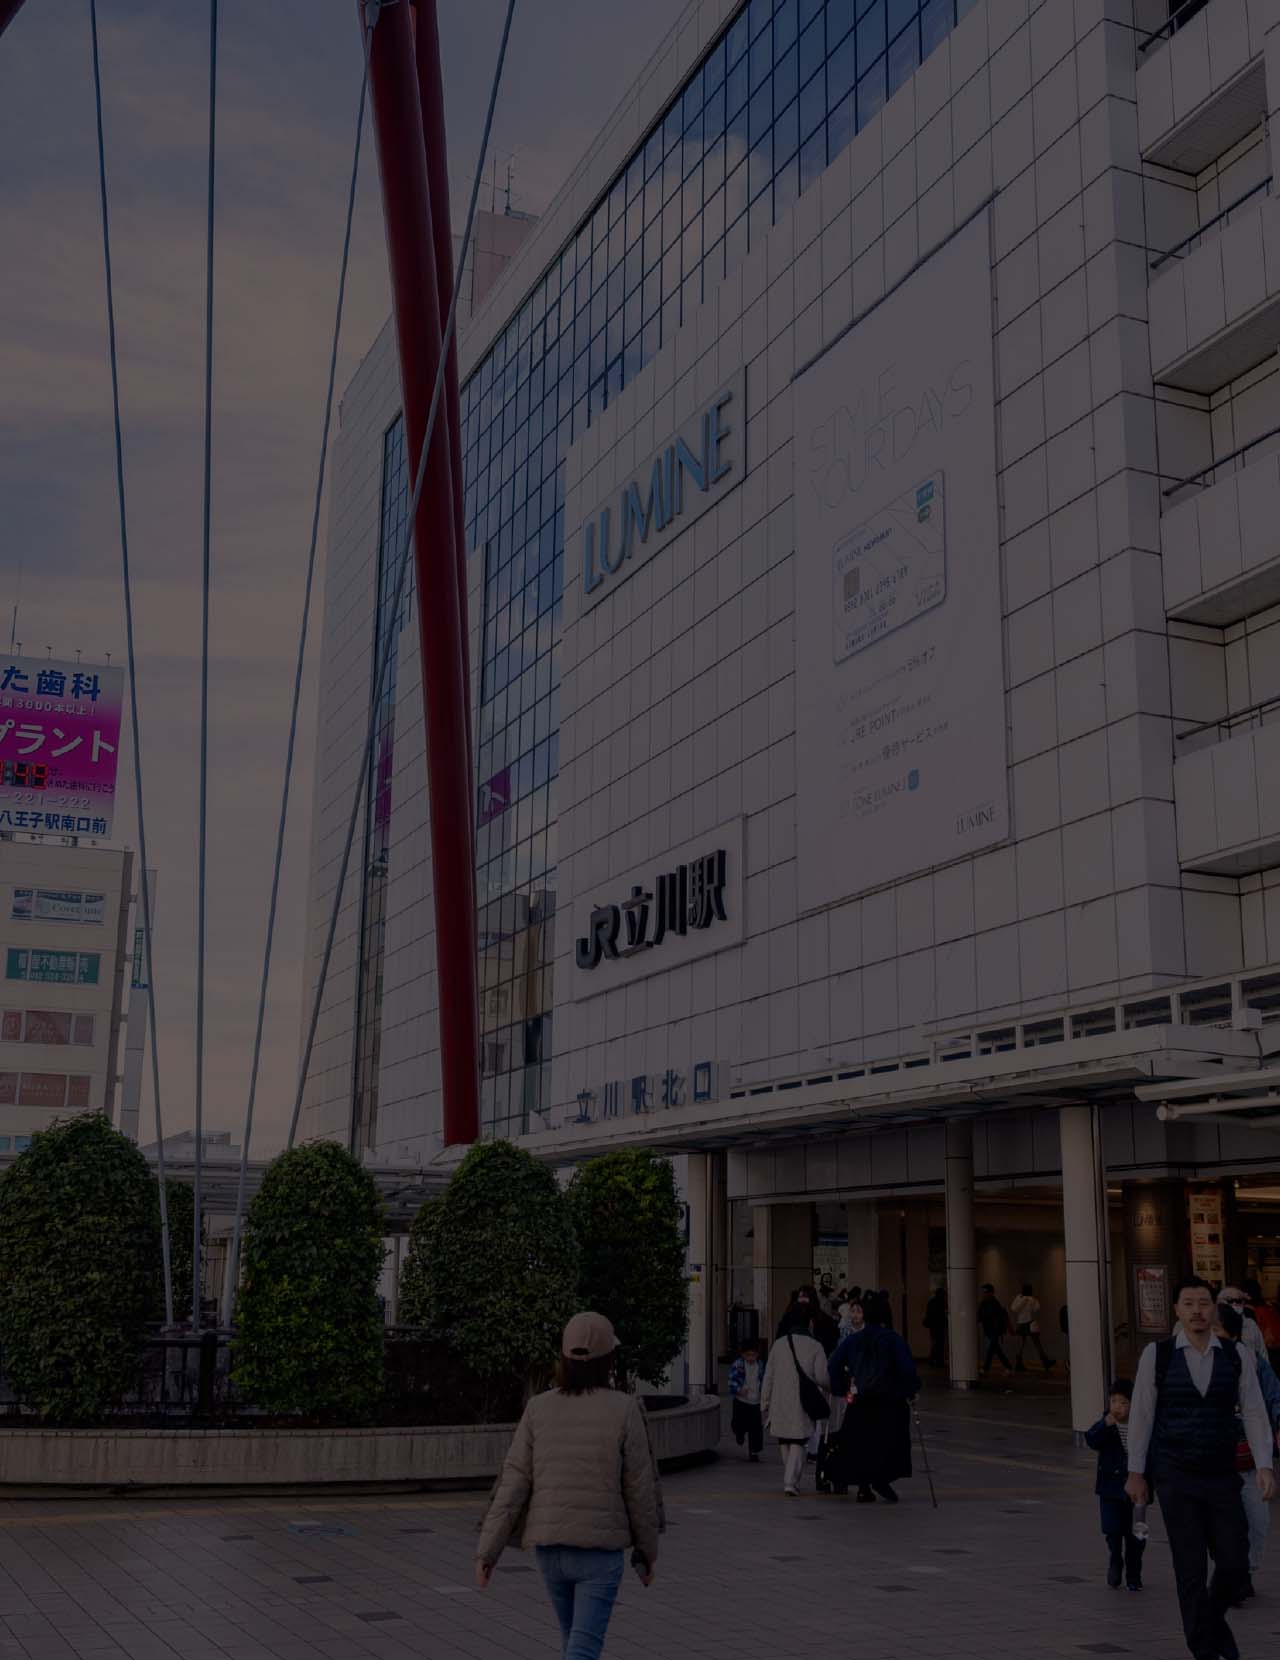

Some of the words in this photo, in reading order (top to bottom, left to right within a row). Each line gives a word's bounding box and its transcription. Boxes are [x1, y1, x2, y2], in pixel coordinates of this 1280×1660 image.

[584, 390, 734, 595] LUMINE
[955, 805, 996, 835] LUMINE
[575, 1060, 712, 1123] 立川駅北口
